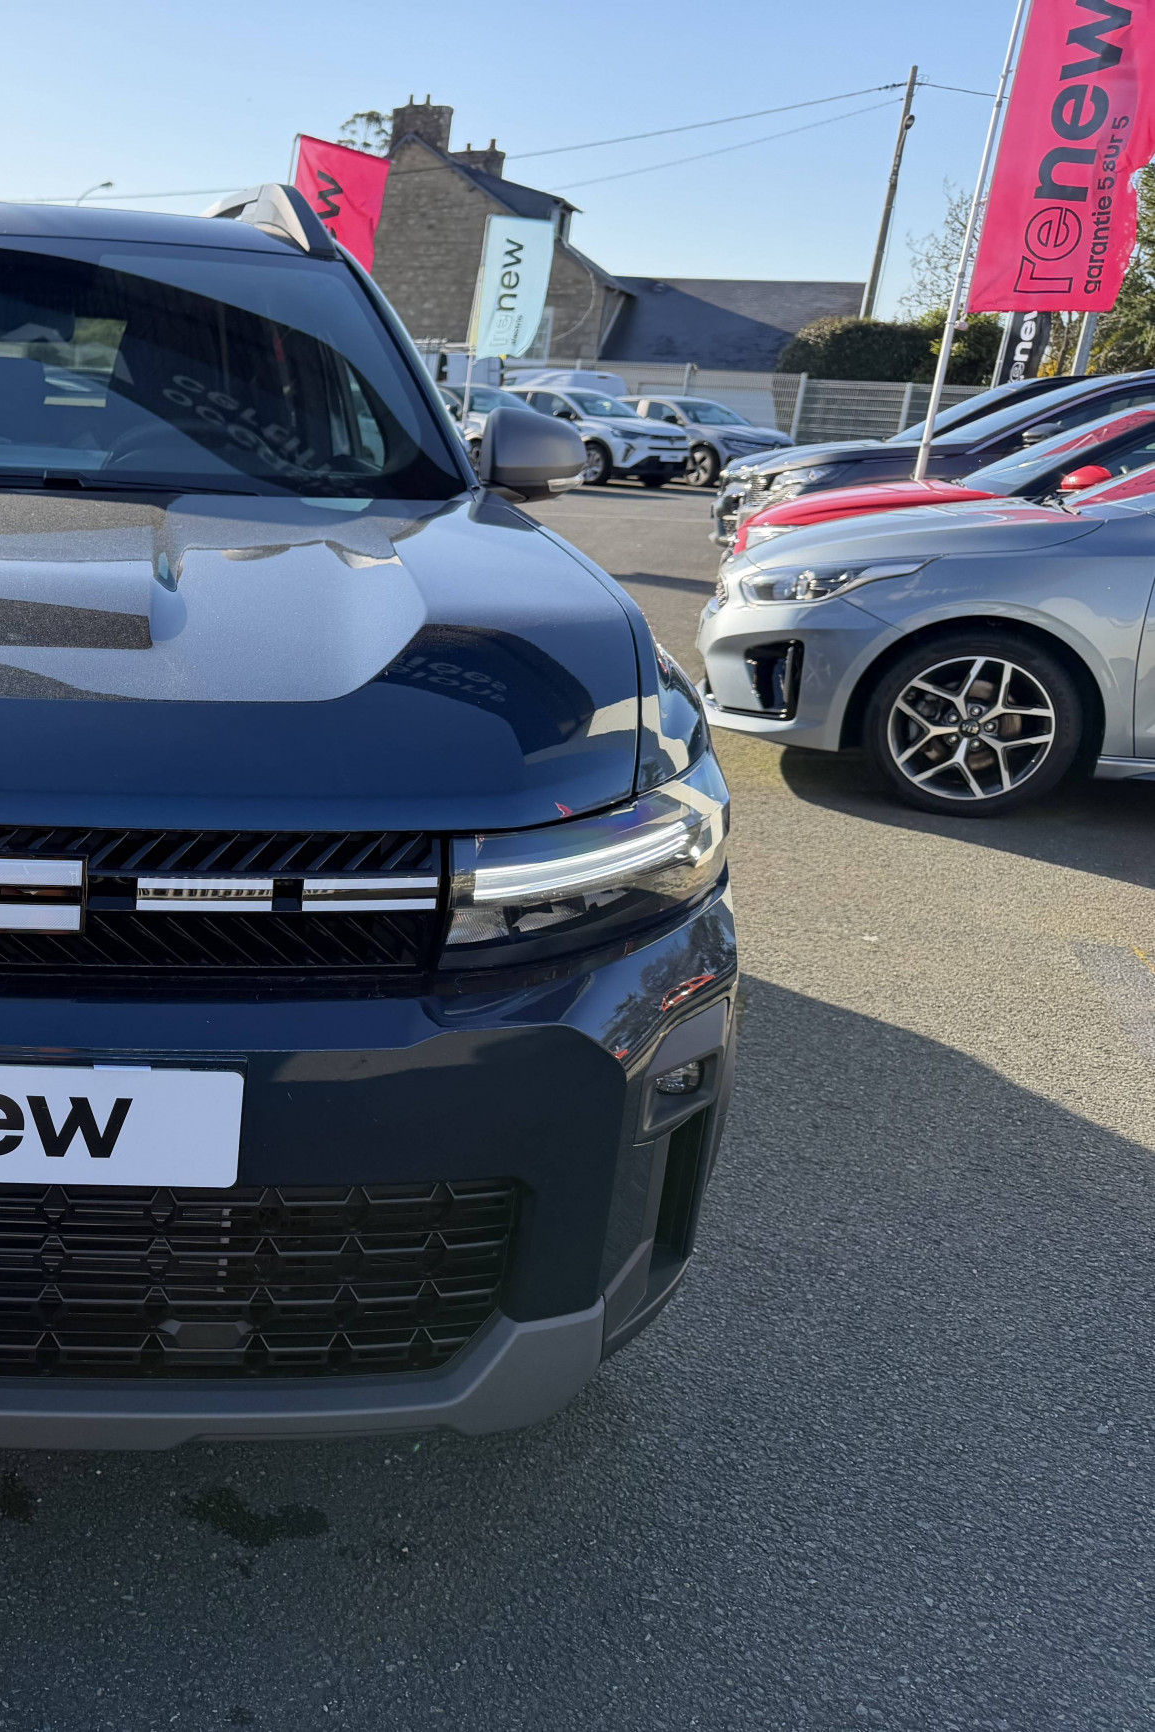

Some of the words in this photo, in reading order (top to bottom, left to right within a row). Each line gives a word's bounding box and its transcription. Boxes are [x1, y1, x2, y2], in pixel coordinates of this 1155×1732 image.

[1112, 115, 1130, 129] 5
[1013, 0, 1133, 294] renew
[1102, 134, 1124, 173] sur
[1098, 176, 1115, 190] 5
[1083, 195, 1113, 294] garantie
